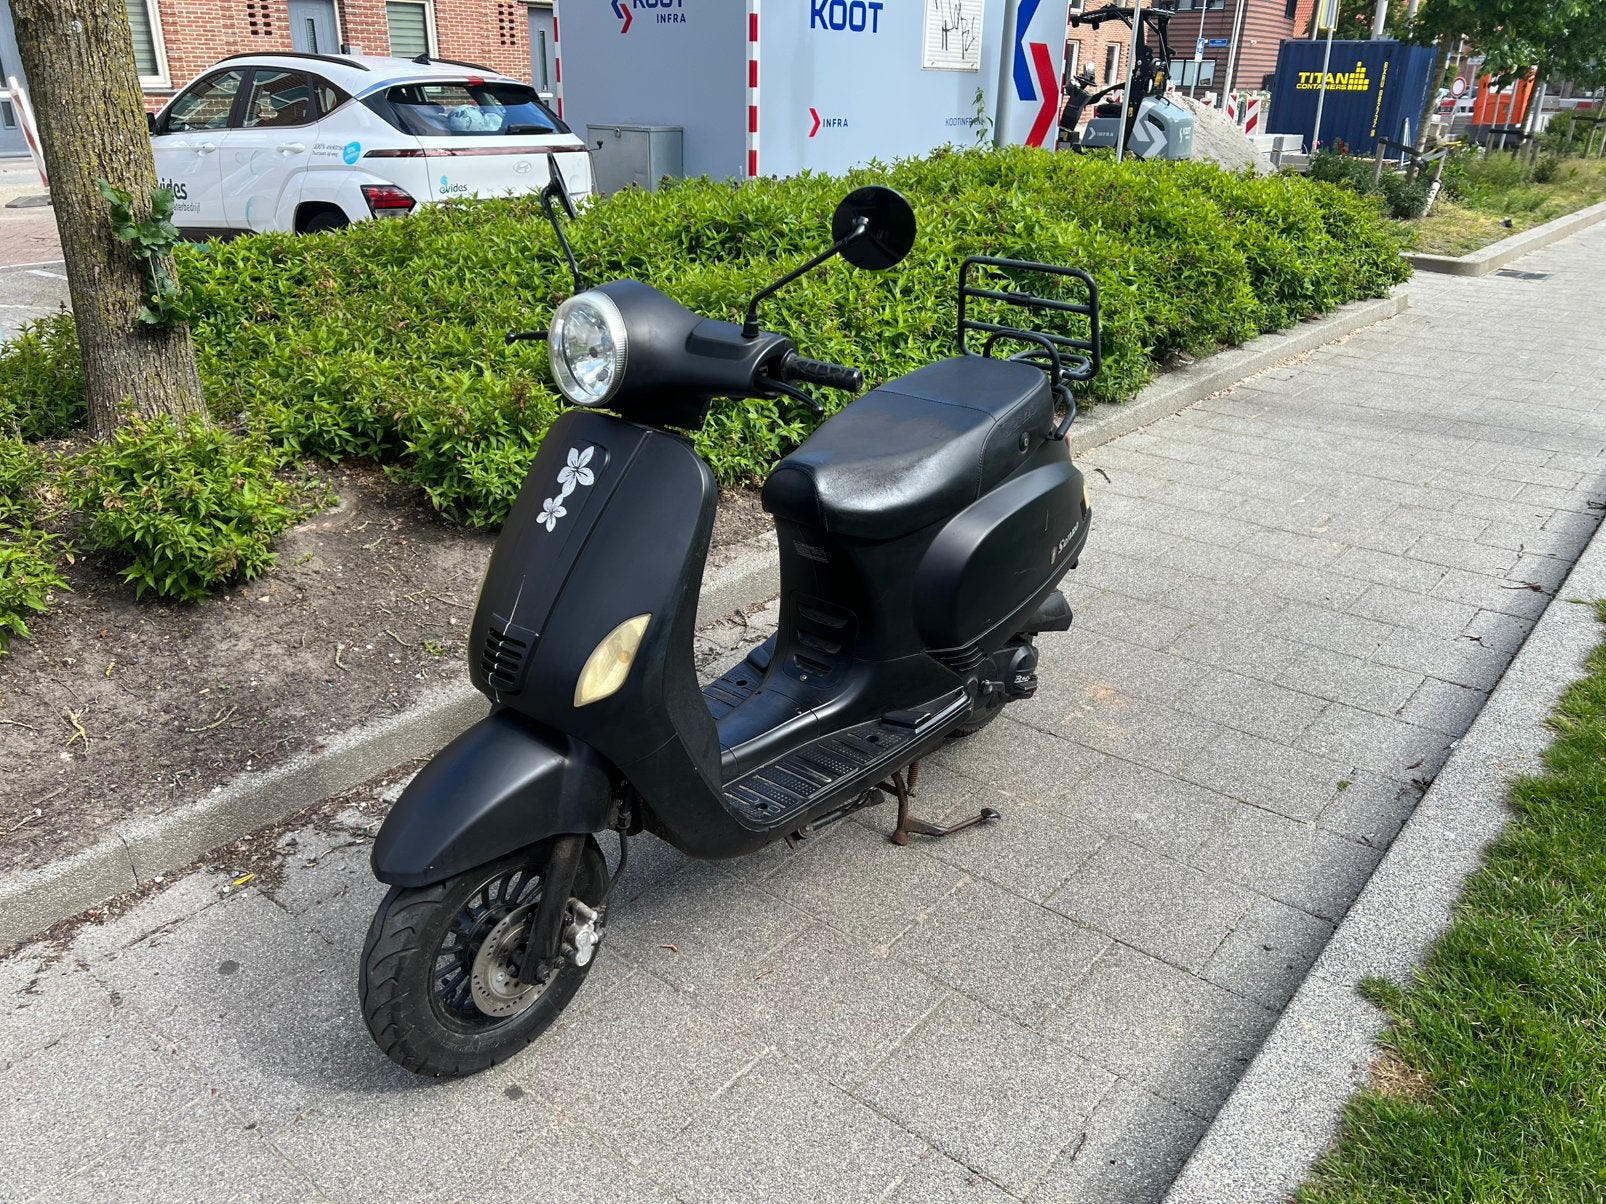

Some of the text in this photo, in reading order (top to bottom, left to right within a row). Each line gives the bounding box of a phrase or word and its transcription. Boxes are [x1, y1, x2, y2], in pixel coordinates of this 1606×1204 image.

[656, 13, 687, 24] INFRA
[810, 0, 884, 33] KOOT
[1298, 72, 1349, 84] TITAN
[822, 118, 849, 128] INFRA
